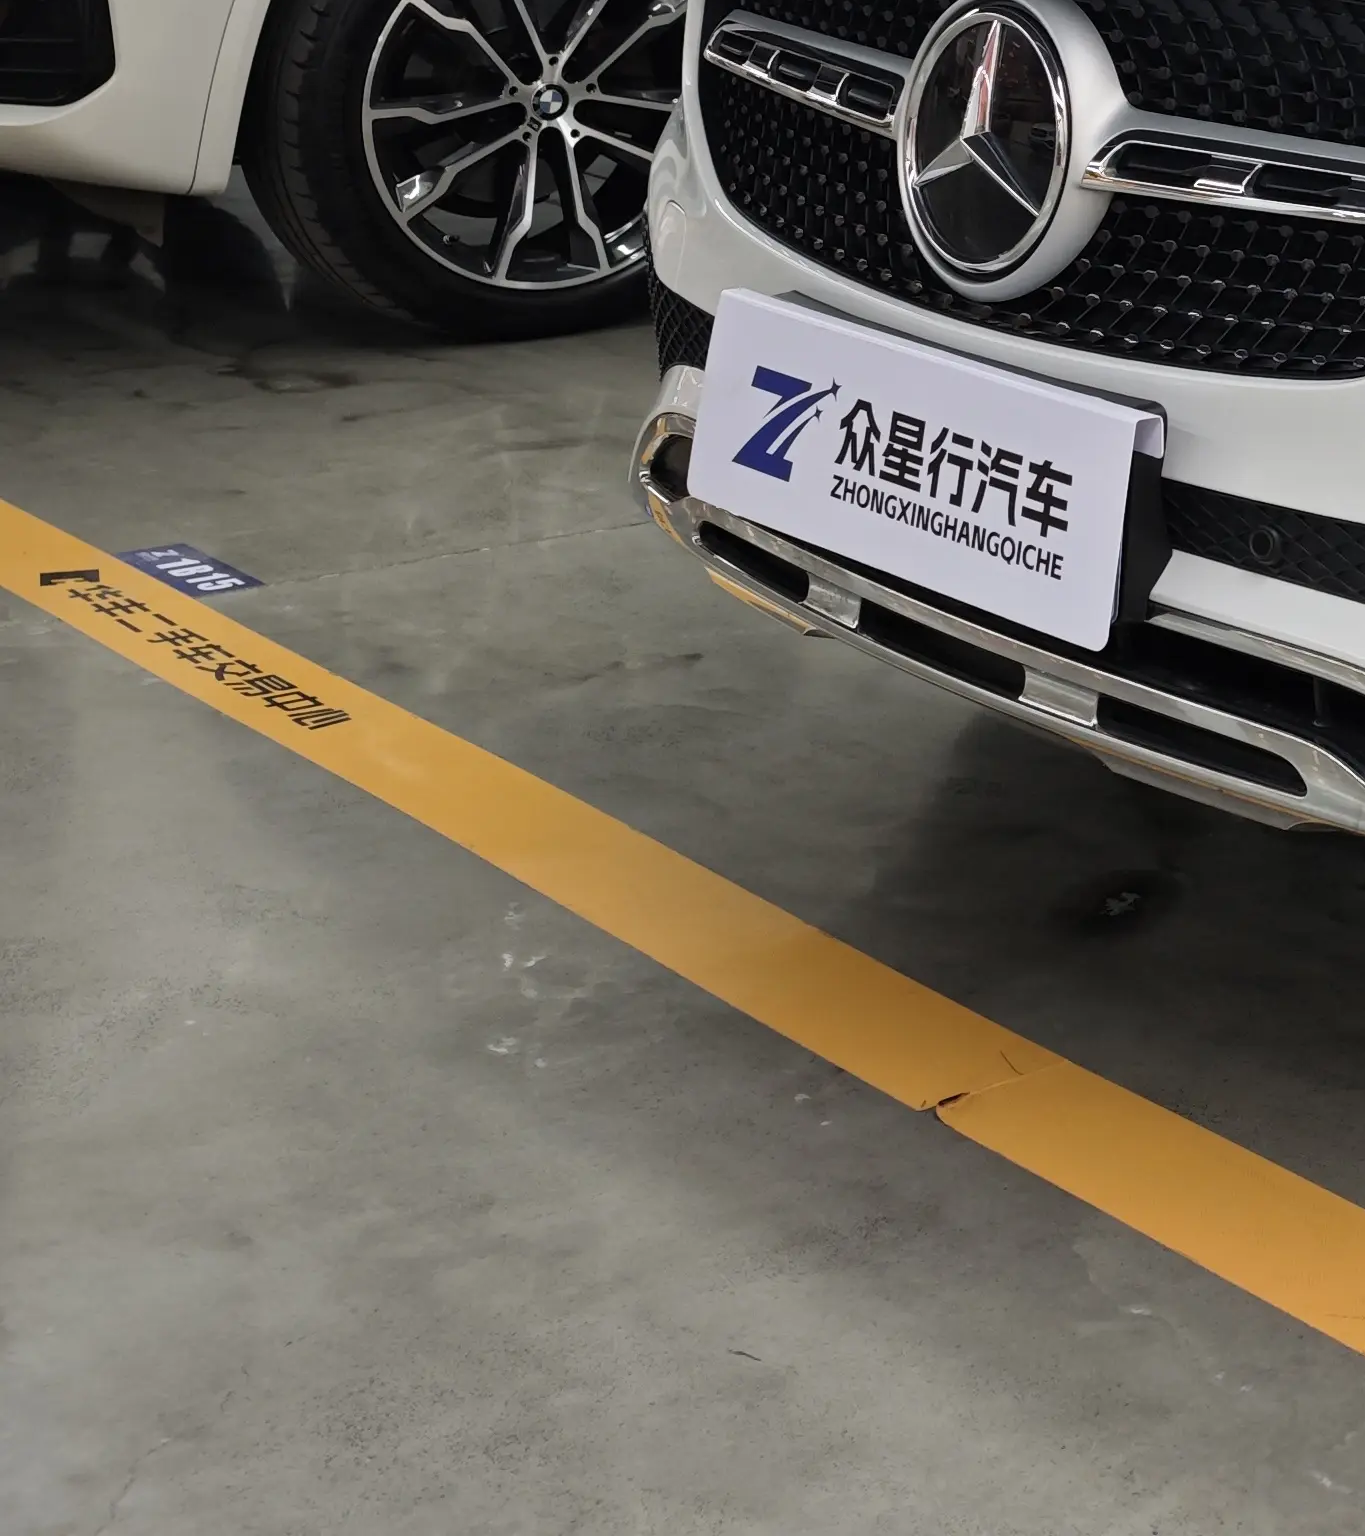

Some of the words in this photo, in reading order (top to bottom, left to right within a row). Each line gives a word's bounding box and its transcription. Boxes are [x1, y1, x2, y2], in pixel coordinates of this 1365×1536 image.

[829, 474, 1064, 581] ZHONGXINGHANGQICHE
[834, 398, 1073, 538] 众星行汽车
[156, 557, 246, 592] 1B15
[67, 584, 352, 731] 华丰二手车交易中心
